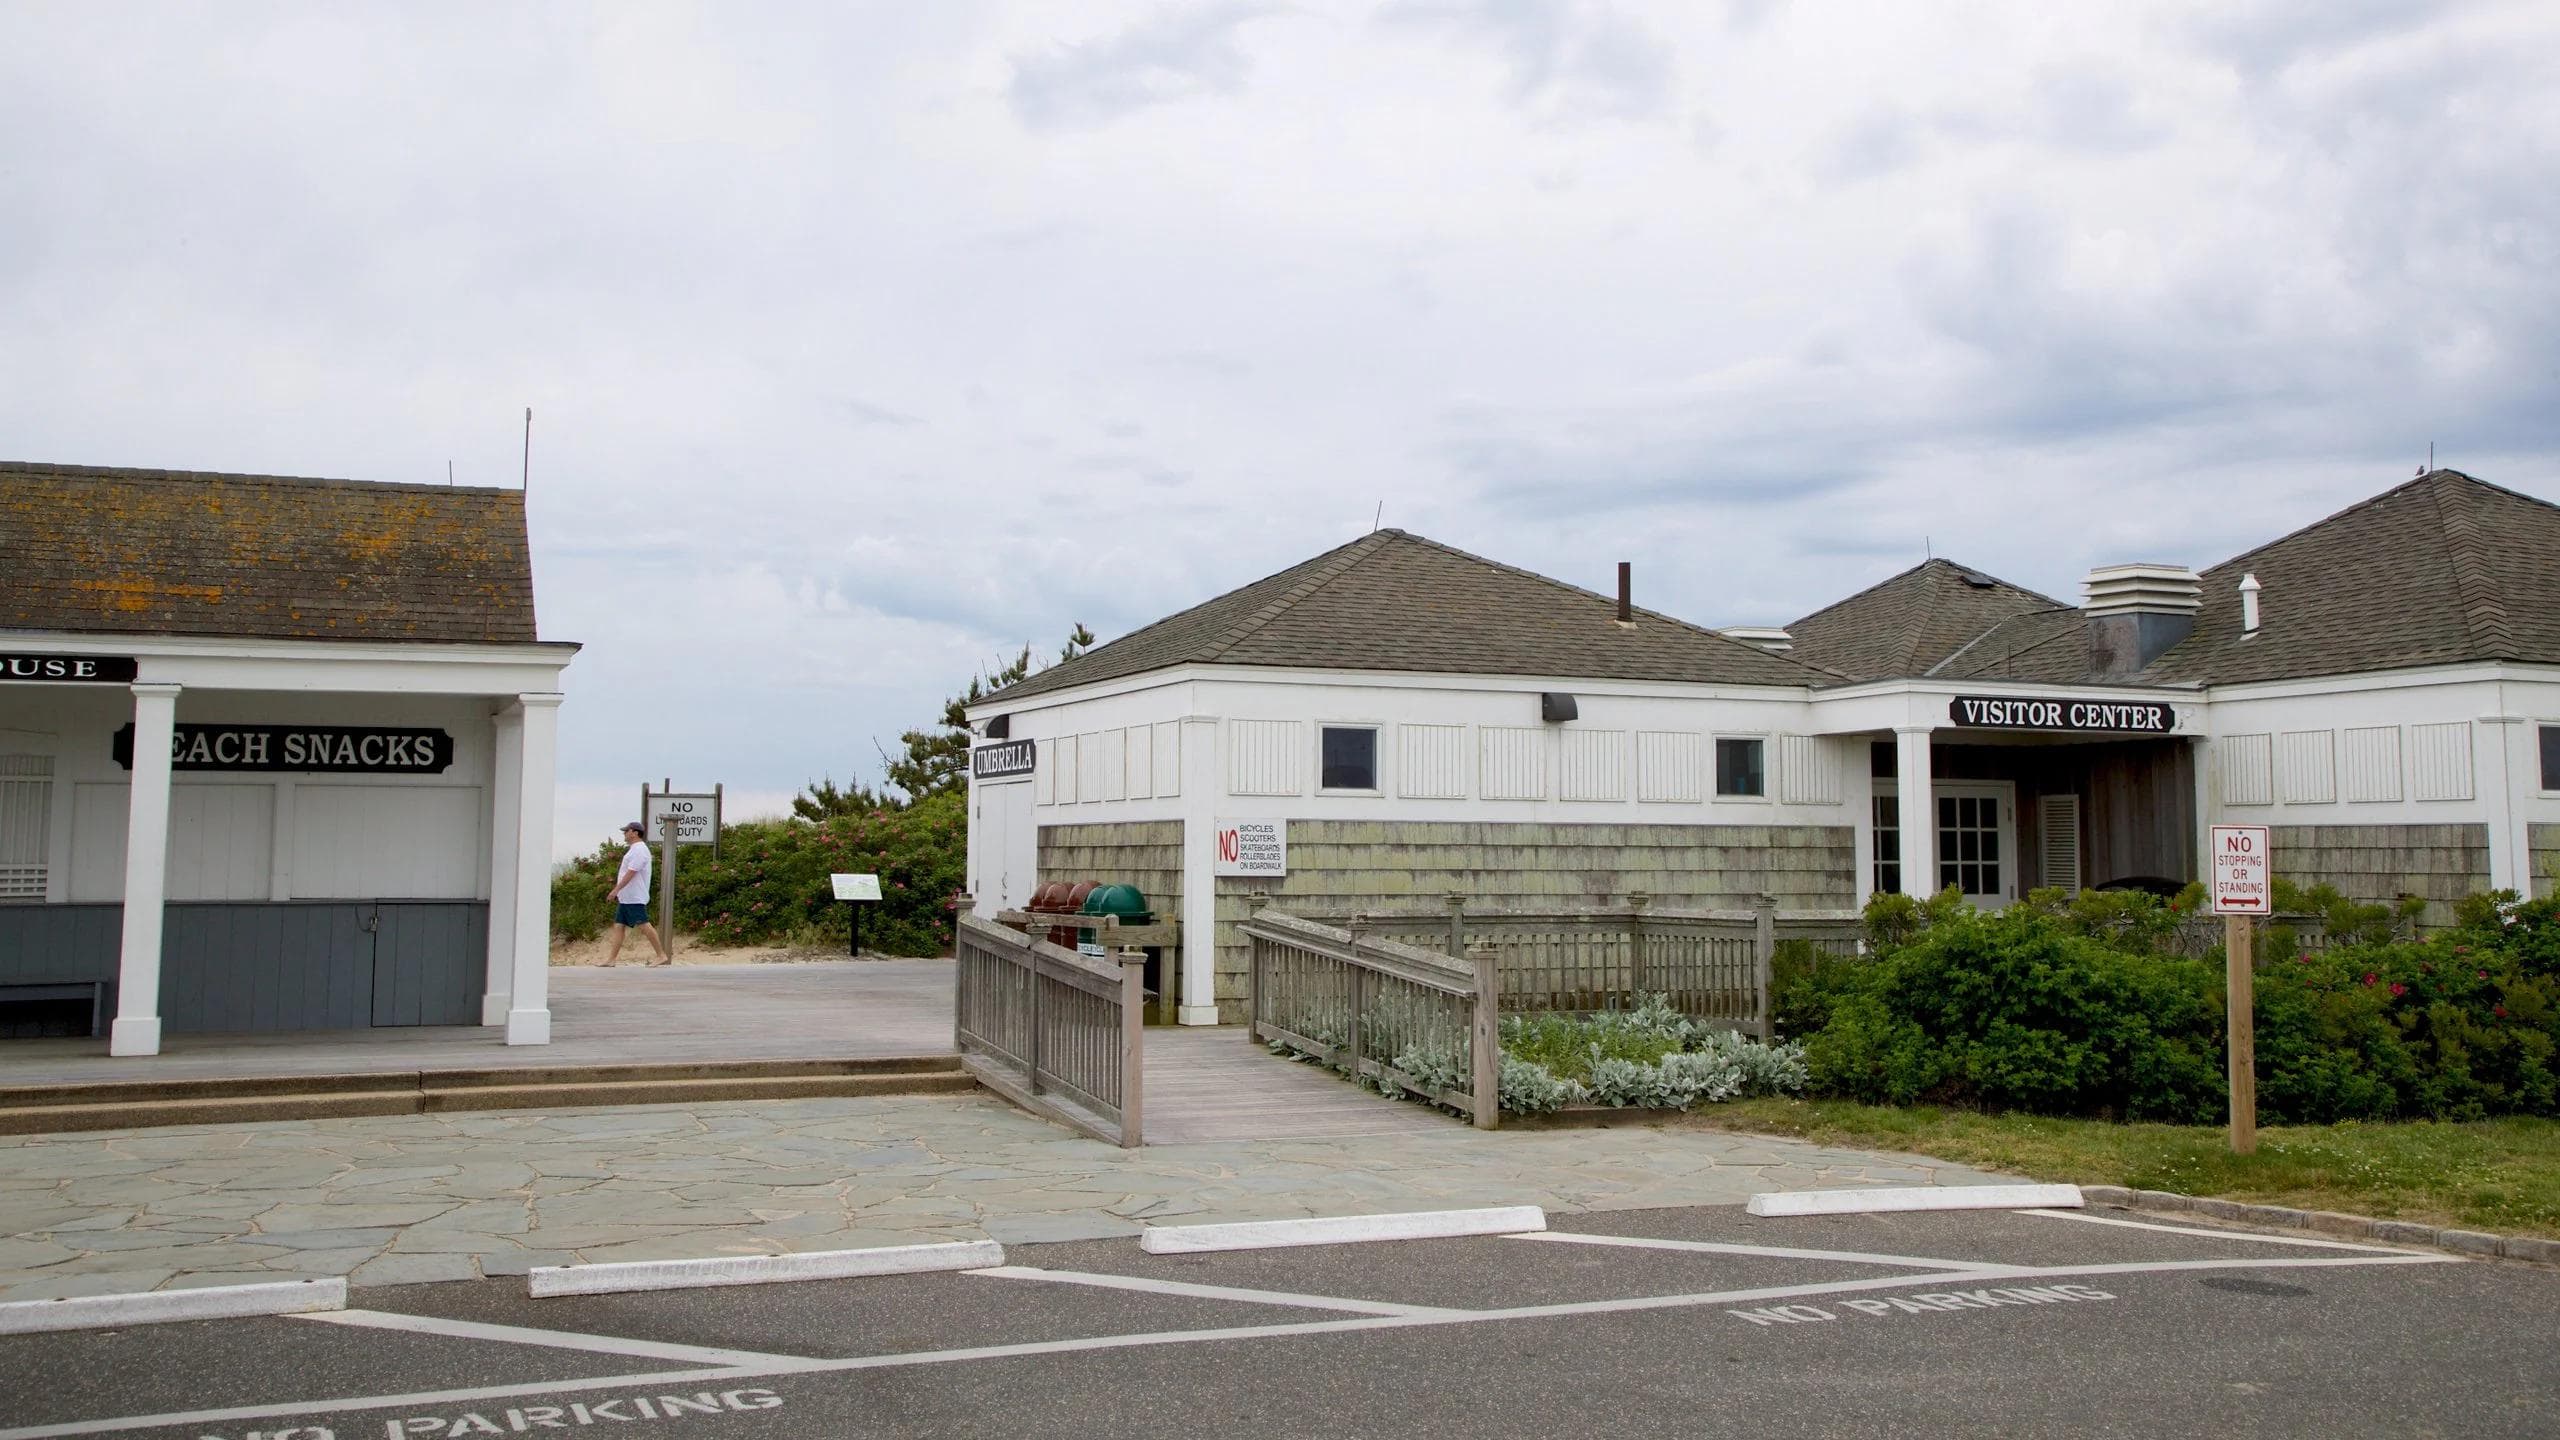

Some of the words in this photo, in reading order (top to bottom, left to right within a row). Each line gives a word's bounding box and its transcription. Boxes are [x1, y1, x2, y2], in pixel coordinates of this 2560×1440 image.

[0, 659, 97, 677] USE
[1963, 700, 2063, 726] VISITOR
[2070, 703, 2163, 730] CENTER
[172, 732, 270, 764] EACH
[284, 734, 435, 766] SNACKS
[977, 744, 1032, 775] UMBRELLA
[671, 802, 693, 813] NO
[677, 827, 703, 836] DUTY
[1240, 825, 1274, 833] BICYCLES
[1240, 834, 1276, 843] SCOOTERS
[2227, 836, 2252, 852] NO
[1219, 829, 1238, 862] NO
[1240, 844, 1280, 852] SKATEBOARDS
[1240, 853, 1281, 861] ROLLERBLADES
[2218, 855, 2262, 866] STOPPING
[1240, 862, 1248, 870] ON
[1249, 862, 1282, 870] BOARDWALK
[2232, 869, 2248, 880] OR
[2219, 882, 2263, 894] STANDING
[1726, 1305, 1836, 1326] NO
[1838, 1285, 2118, 1317] PARKING
[386, 1388, 783, 1440] PARKING
